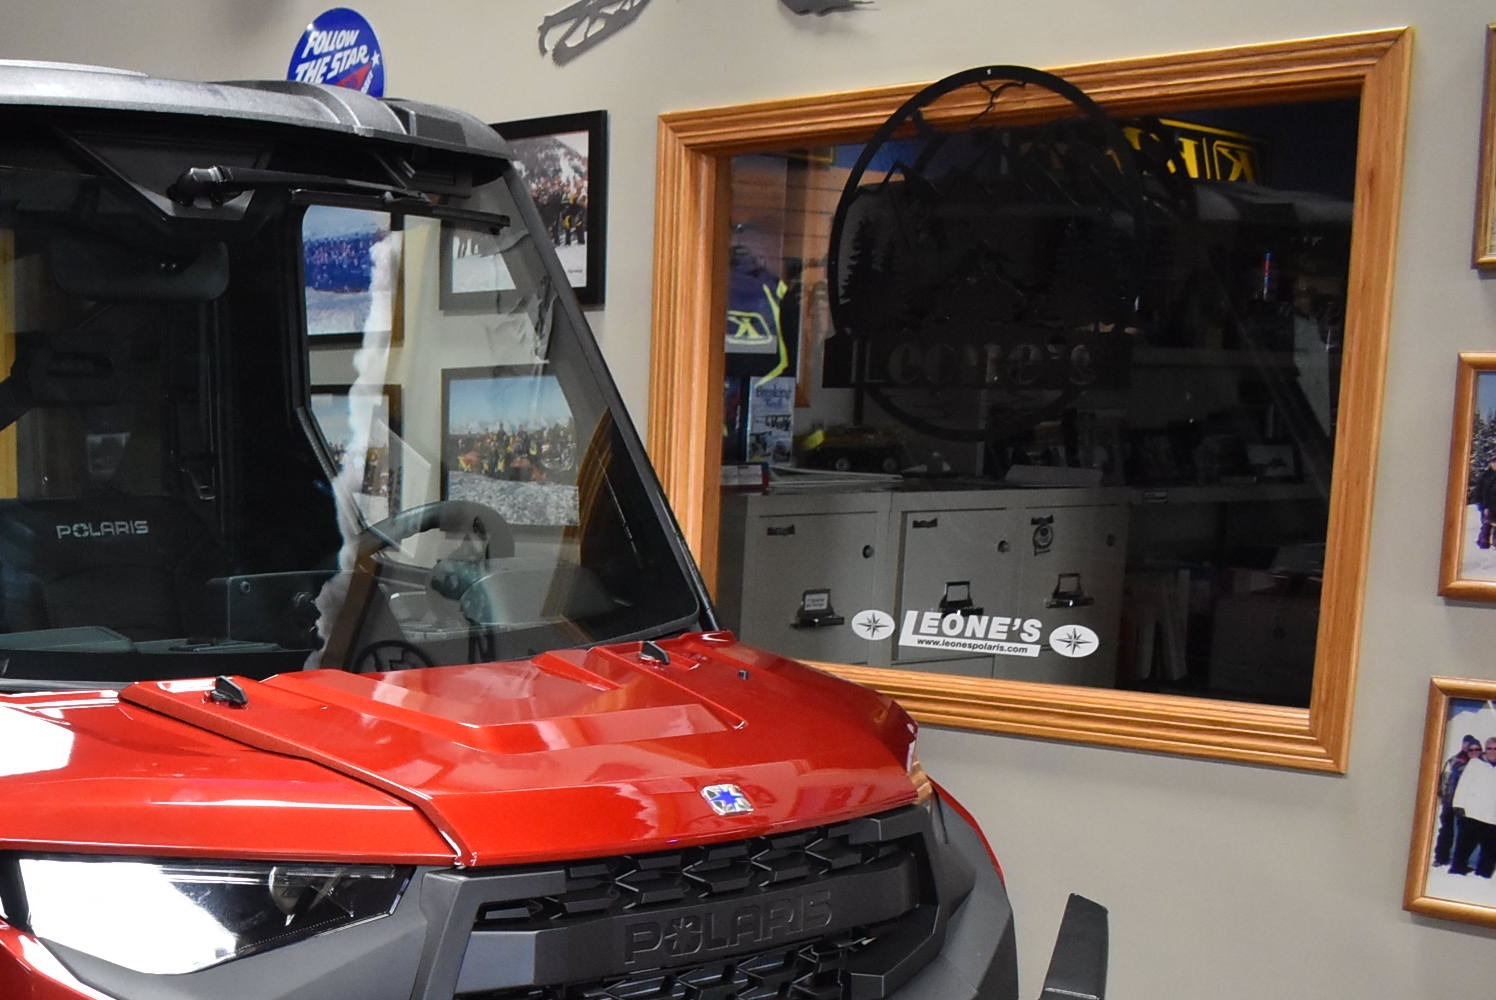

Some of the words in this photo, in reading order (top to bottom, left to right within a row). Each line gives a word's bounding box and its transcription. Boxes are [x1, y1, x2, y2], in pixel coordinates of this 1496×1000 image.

[301, 29, 360, 59] FOLLOW
[295, 55, 332, 85] THE
[326, 44, 370, 80] STAR
[56, 520, 149, 539] POLARIS
[916, 637, 1029, 654] www.leonespolaris.com
[624, 890, 832, 965] POLARIS
